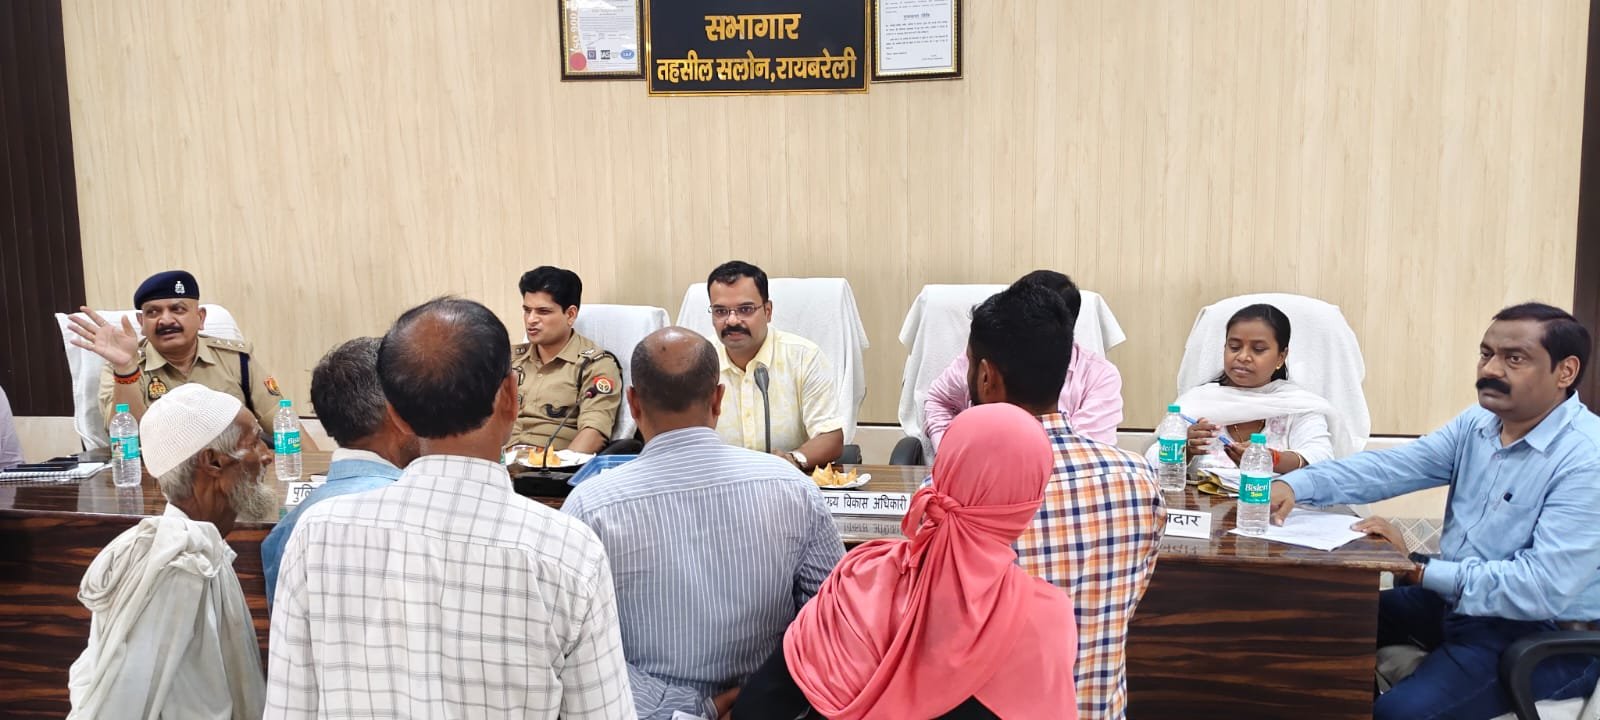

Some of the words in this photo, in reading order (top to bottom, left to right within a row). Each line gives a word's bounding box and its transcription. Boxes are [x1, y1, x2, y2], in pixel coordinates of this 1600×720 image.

[704, 13, 802, 41] सभागार
[656, 49, 714, 82] तहसील
[1245, 483, 1268, 492] Bisleri
[843, 494, 869, 509] विकास
[873, 494, 907, 510] अधिकारी
